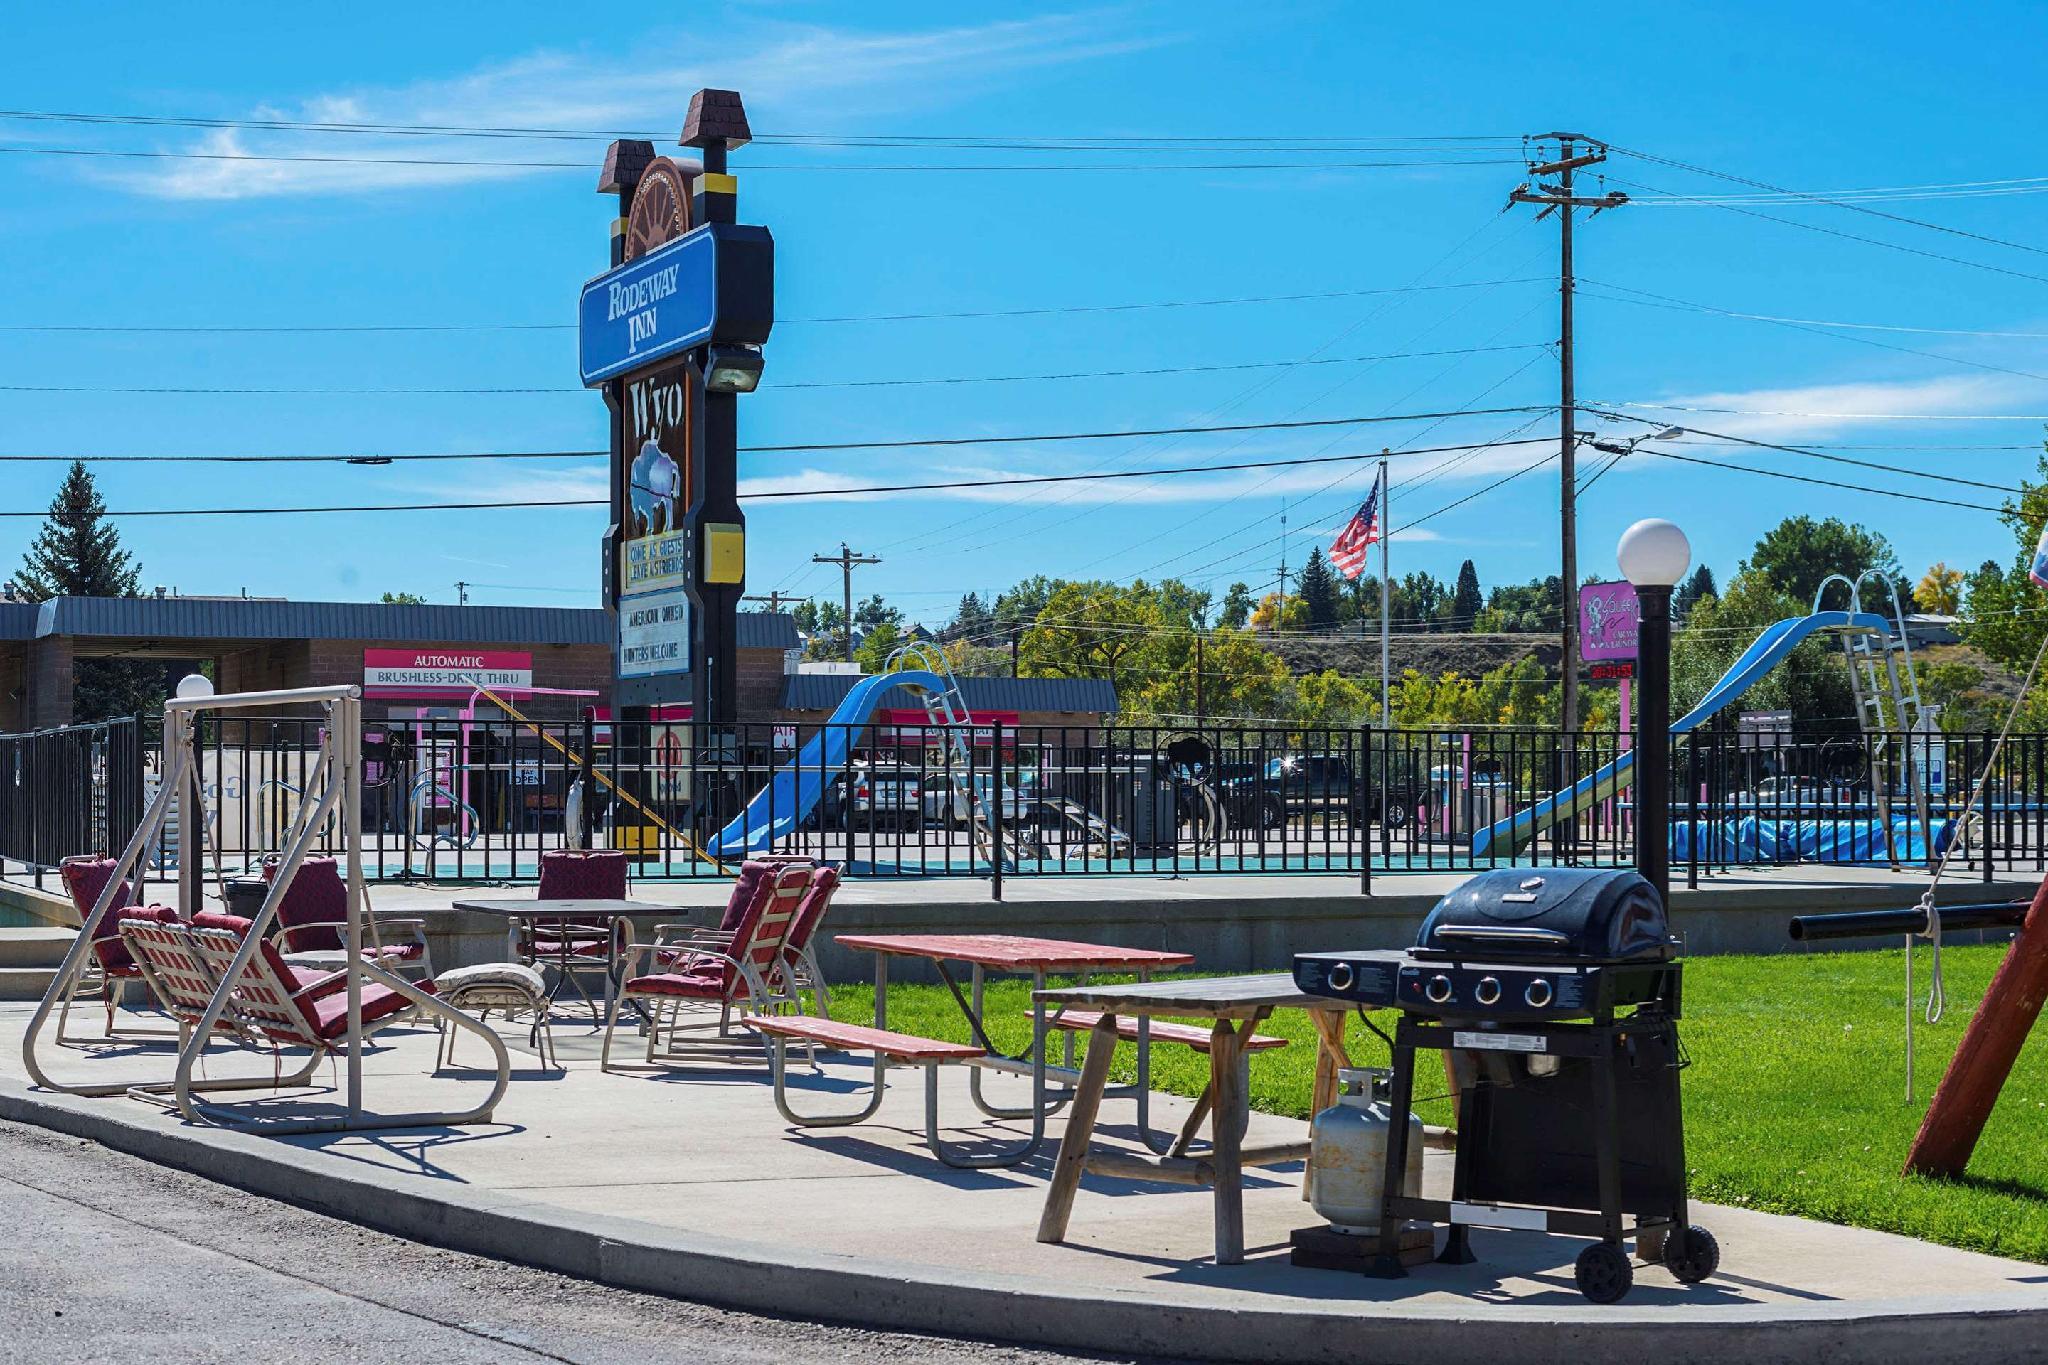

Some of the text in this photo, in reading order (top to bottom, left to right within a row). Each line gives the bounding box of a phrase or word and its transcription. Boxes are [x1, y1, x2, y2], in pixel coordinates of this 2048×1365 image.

[608, 263, 680, 322] RODEWAY
[628, 306, 657, 354] INN
[631, 539, 683, 562] COME AS GUESTS
[630, 562, 648, 580] LEAVE
[660, 556, 683, 575] FRIENDS
[629, 604, 684, 627] AMERICAN OWNED
[414, 655, 484, 668] AUTOMATIC
[624, 642, 678, 663] HUNTERS WELCOME
[486, 672, 519, 684] THRU
